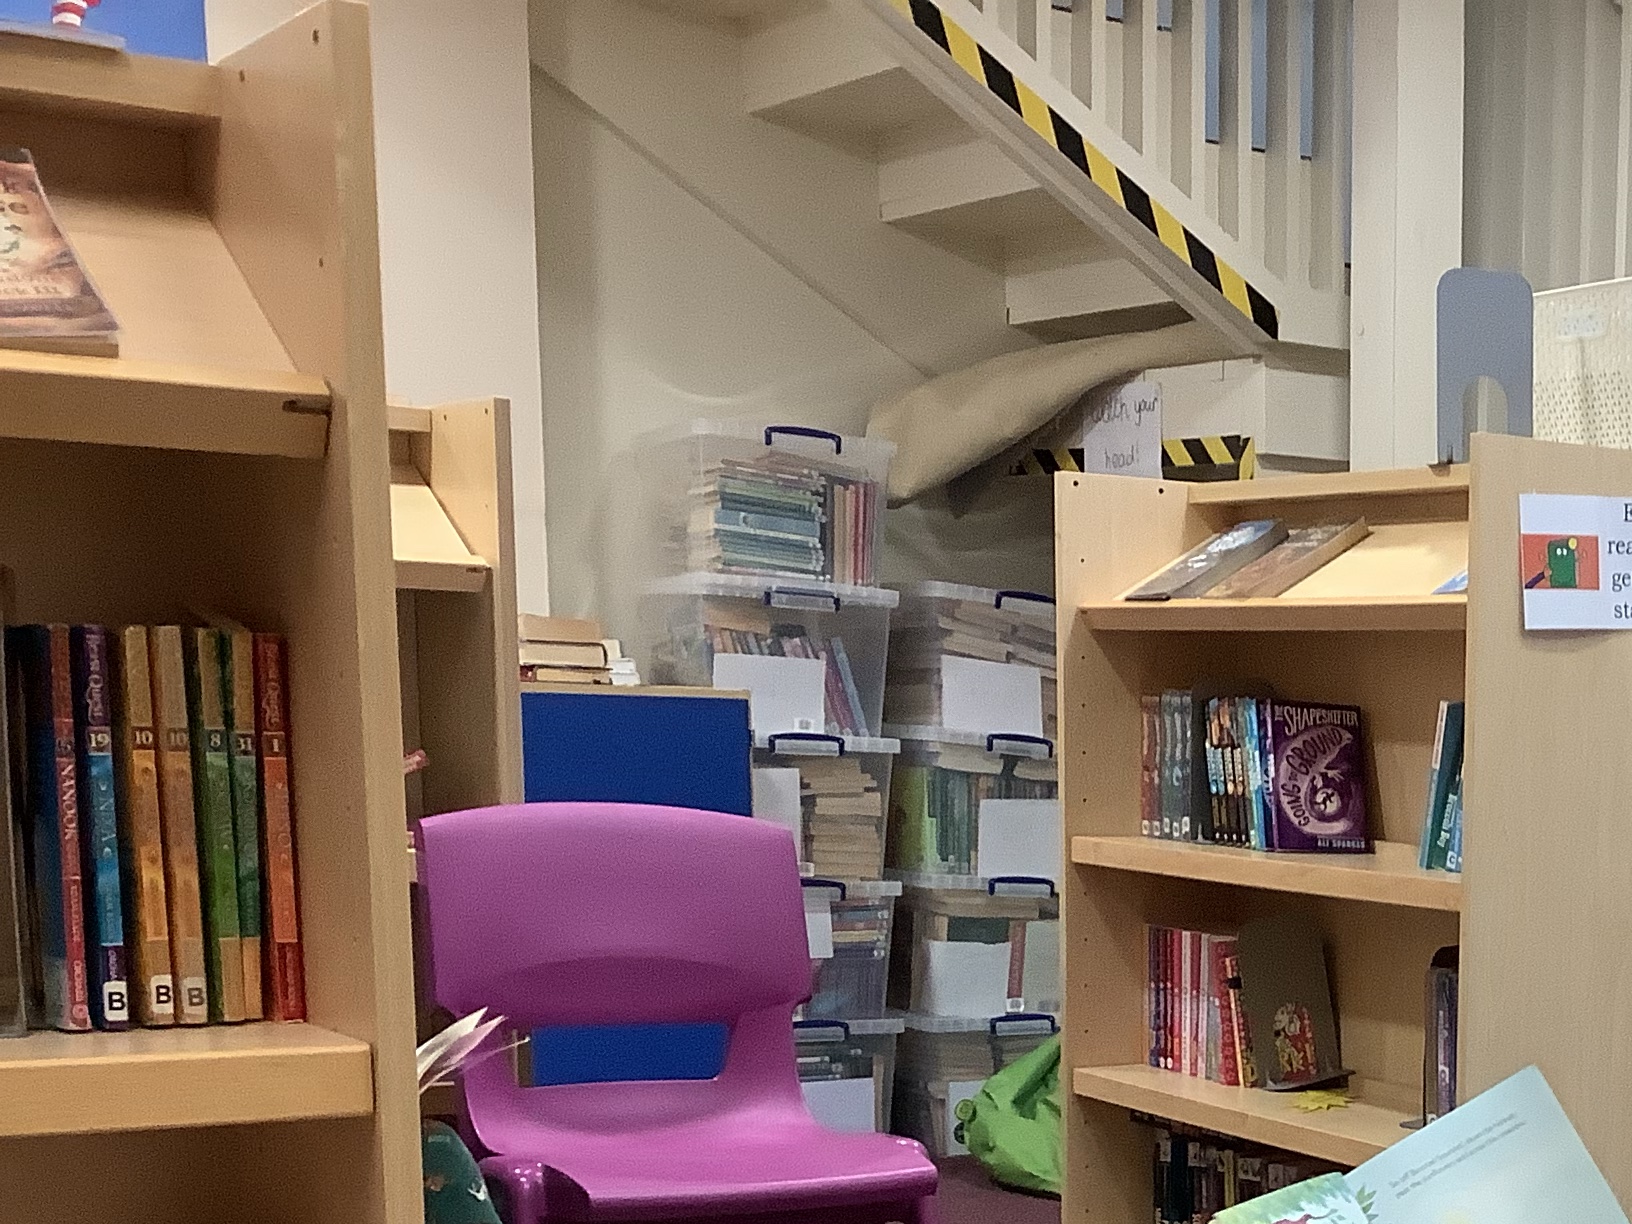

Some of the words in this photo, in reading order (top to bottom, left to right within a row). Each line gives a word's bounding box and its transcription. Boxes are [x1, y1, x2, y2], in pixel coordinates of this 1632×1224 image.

[1134, 397, 1158, 426] your
[1104, 444, 1140, 470] head!
[1284, 705, 1359, 736] SHAPESHIFTER
[90, 733, 109, 748] 19
[134, 730, 153, 745] 10
[168, 730, 187, 747] 10
[210, 734, 221, 748] 8
[1286, 727, 1344, 776] GROUND
[61, 765, 79, 840] NANOOK
[1281, 783, 1311, 828] GOING
[1436, 830, 1450, 848] Boy
[109, 991, 125, 1010] B
[156, 985, 171, 1004] B
[187, 987, 204, 1006] B
